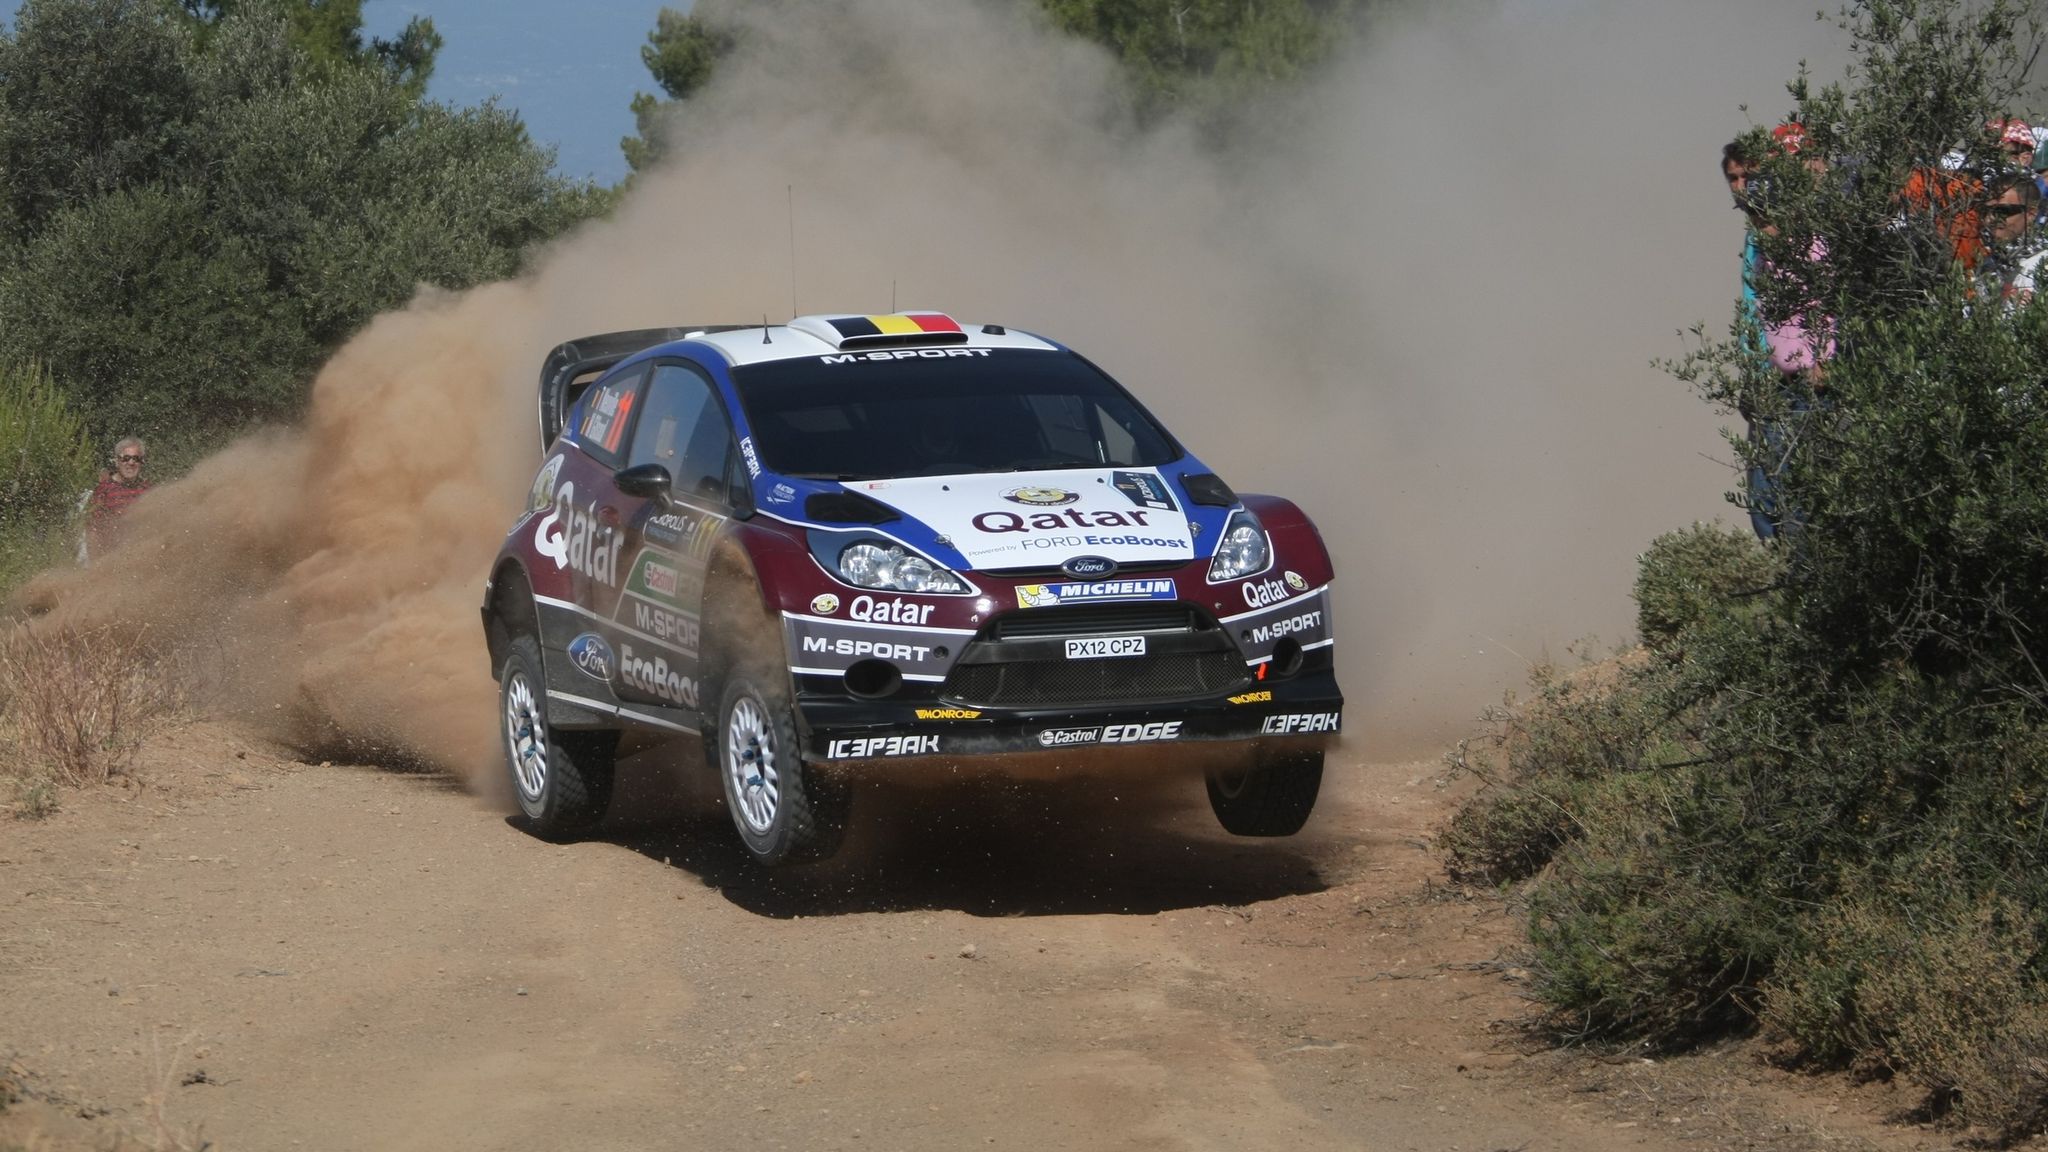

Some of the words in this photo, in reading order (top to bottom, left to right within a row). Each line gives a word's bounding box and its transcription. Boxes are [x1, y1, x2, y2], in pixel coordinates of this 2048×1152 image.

[820, 348, 993, 364] M-SPORT
[971, 508, 1149, 533] Qatar
[535, 480, 625, 588] Qatar
[1021, 536, 1082, 550] FORD
[1085, 535, 1187, 549] EcoBoost
[1075, 561, 1105, 572] Ford
[926, 582, 961, 591] PIAA
[1060, 581, 1171, 596] MICHELIN
[1242, 578, 1290, 608] Qatar
[849, 595, 935, 625] Qatar
[1252, 610, 1322, 644] M-SPORT
[578, 638, 610, 675] Ford
[803, 637, 930, 662] M-SPORT
[1068, 641, 1105, 656] PX12
[1110, 638, 1142, 653] CPZ
[921, 709, 973, 719] MONROE
[1054, 729, 1098, 743] Castrol
[1100, 721, 1183, 743] EDGE
